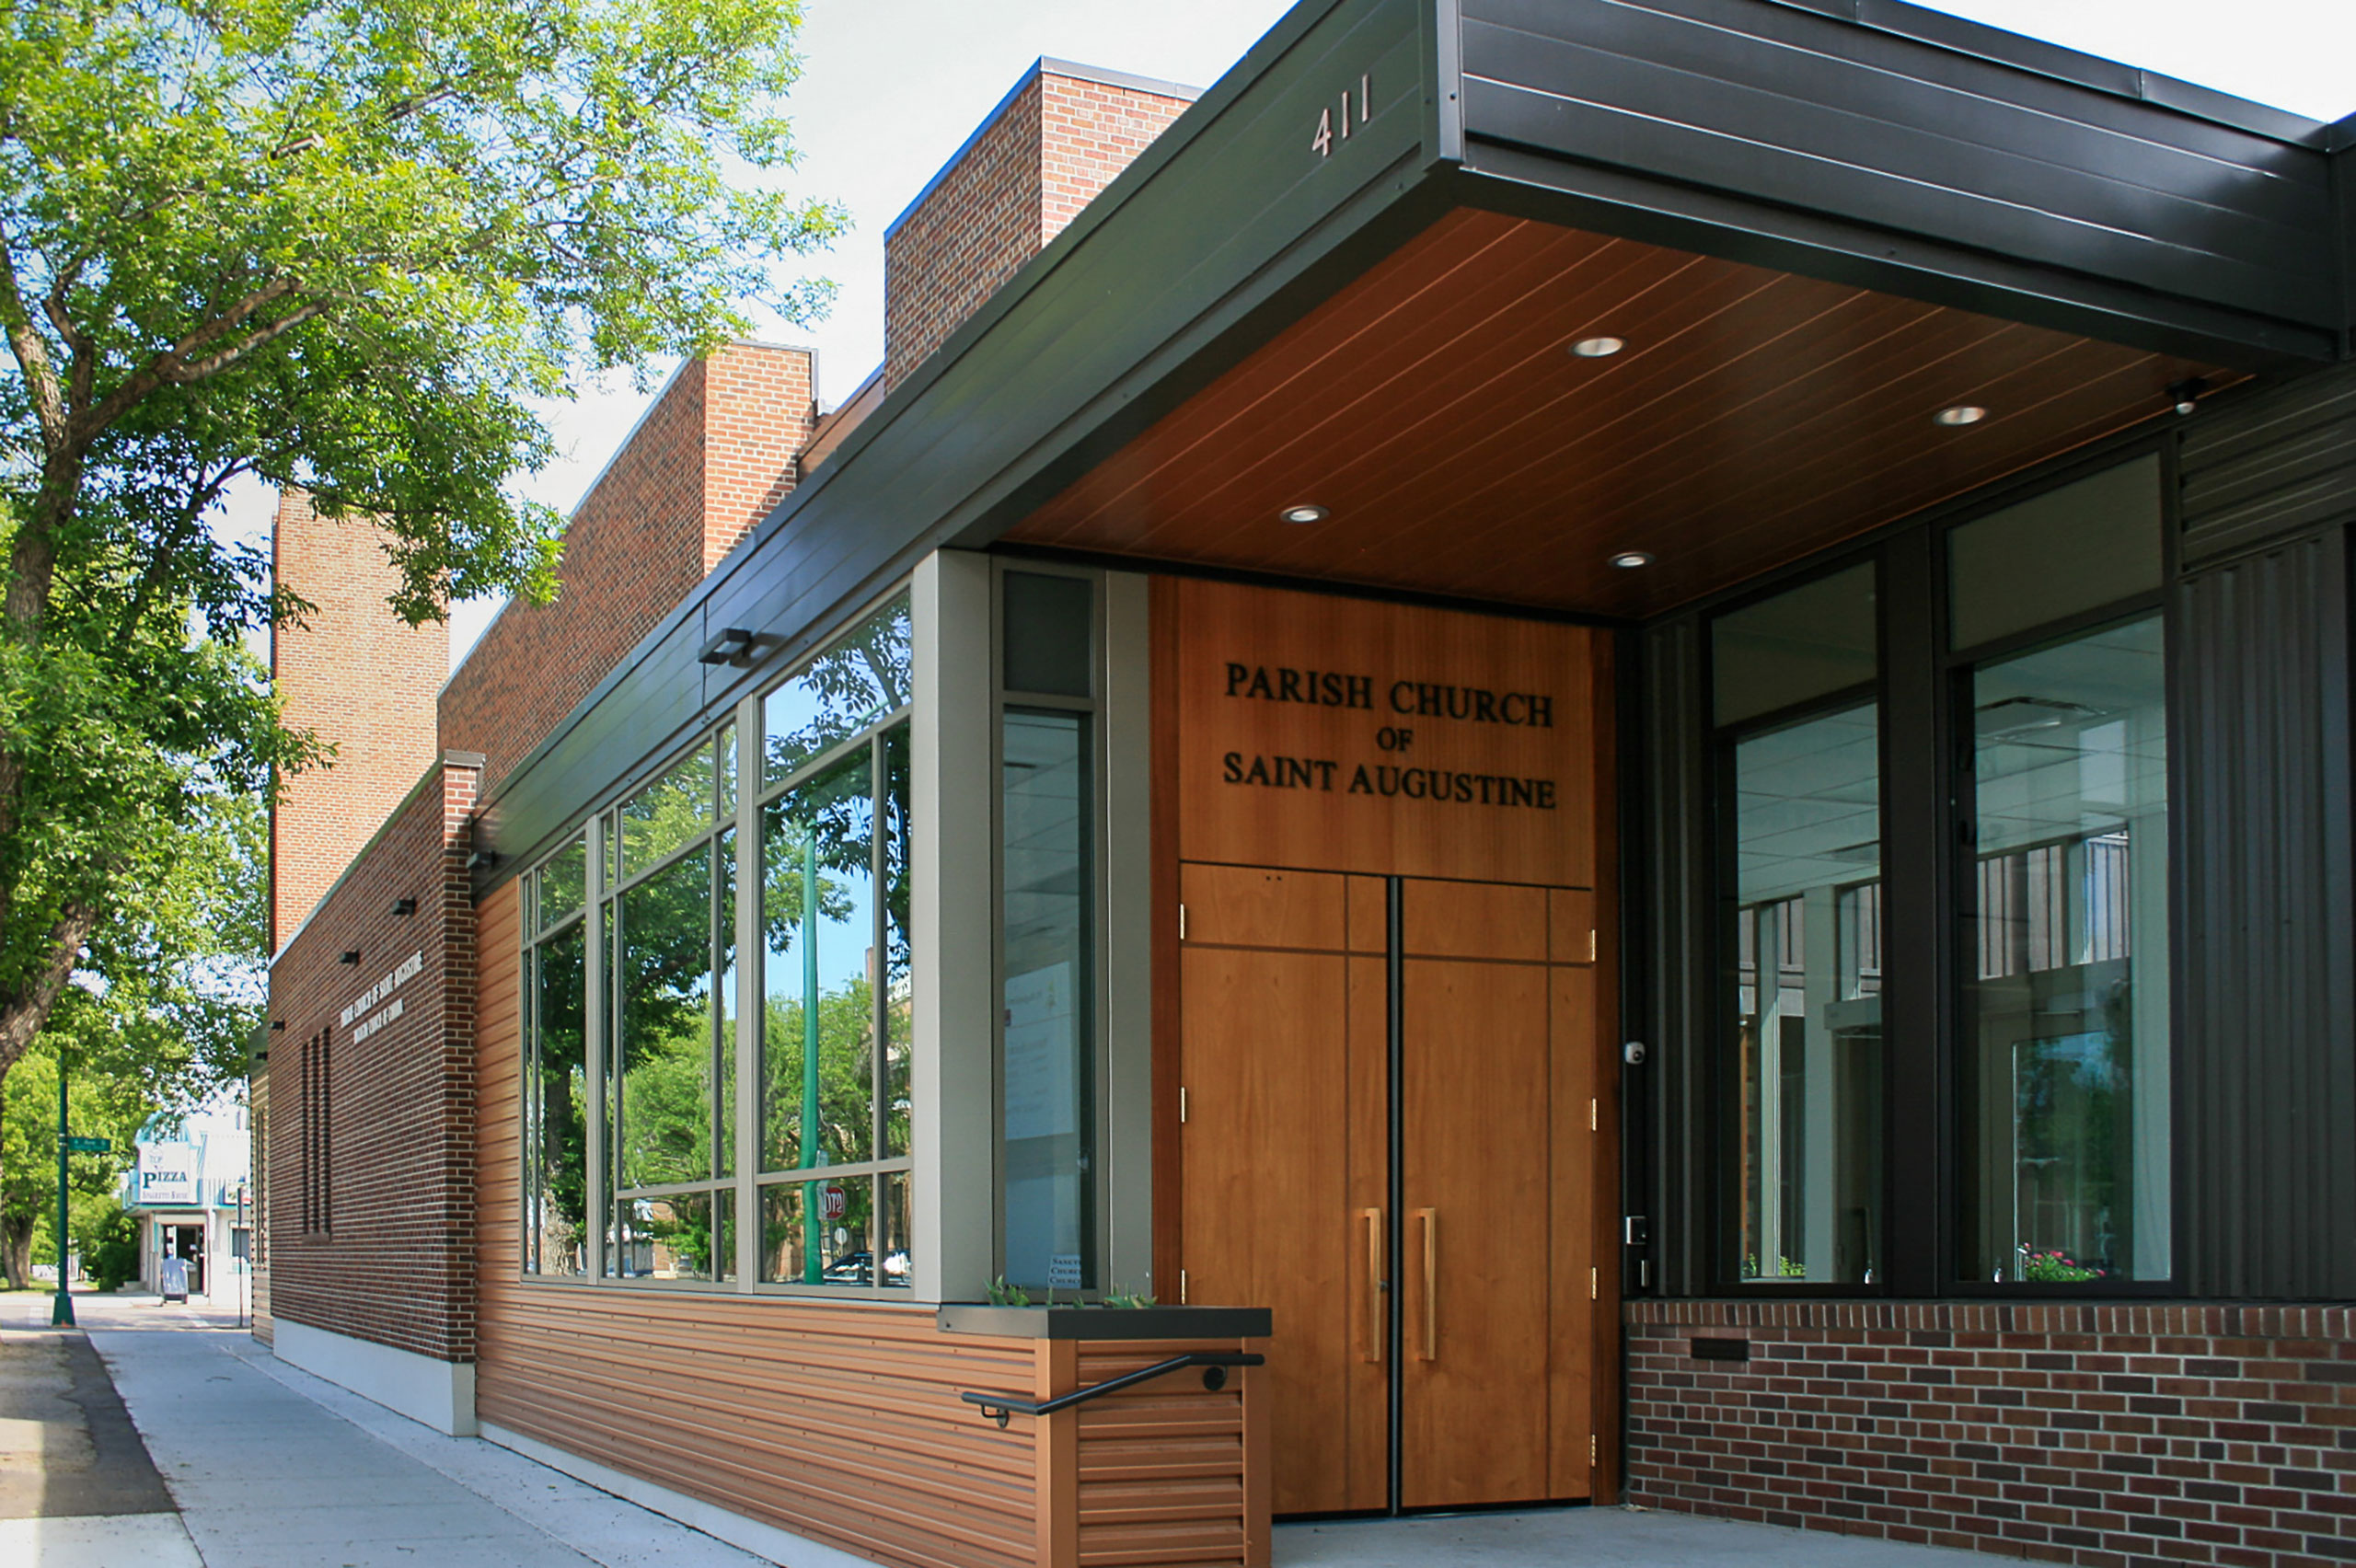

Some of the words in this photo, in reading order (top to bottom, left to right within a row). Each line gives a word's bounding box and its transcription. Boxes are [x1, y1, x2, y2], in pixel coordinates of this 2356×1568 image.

[1311, 73, 1369, 156] 411
[1224, 662, 1373, 709] PARISH
[1389, 681, 1554, 728] CHURCH
[1376, 727, 1414, 752] OF
[1223, 752, 1337, 791] SAINT
[1347, 763, 1557, 810] AUGUSTINE
[142, 1170, 188, 1189] PIZZA
